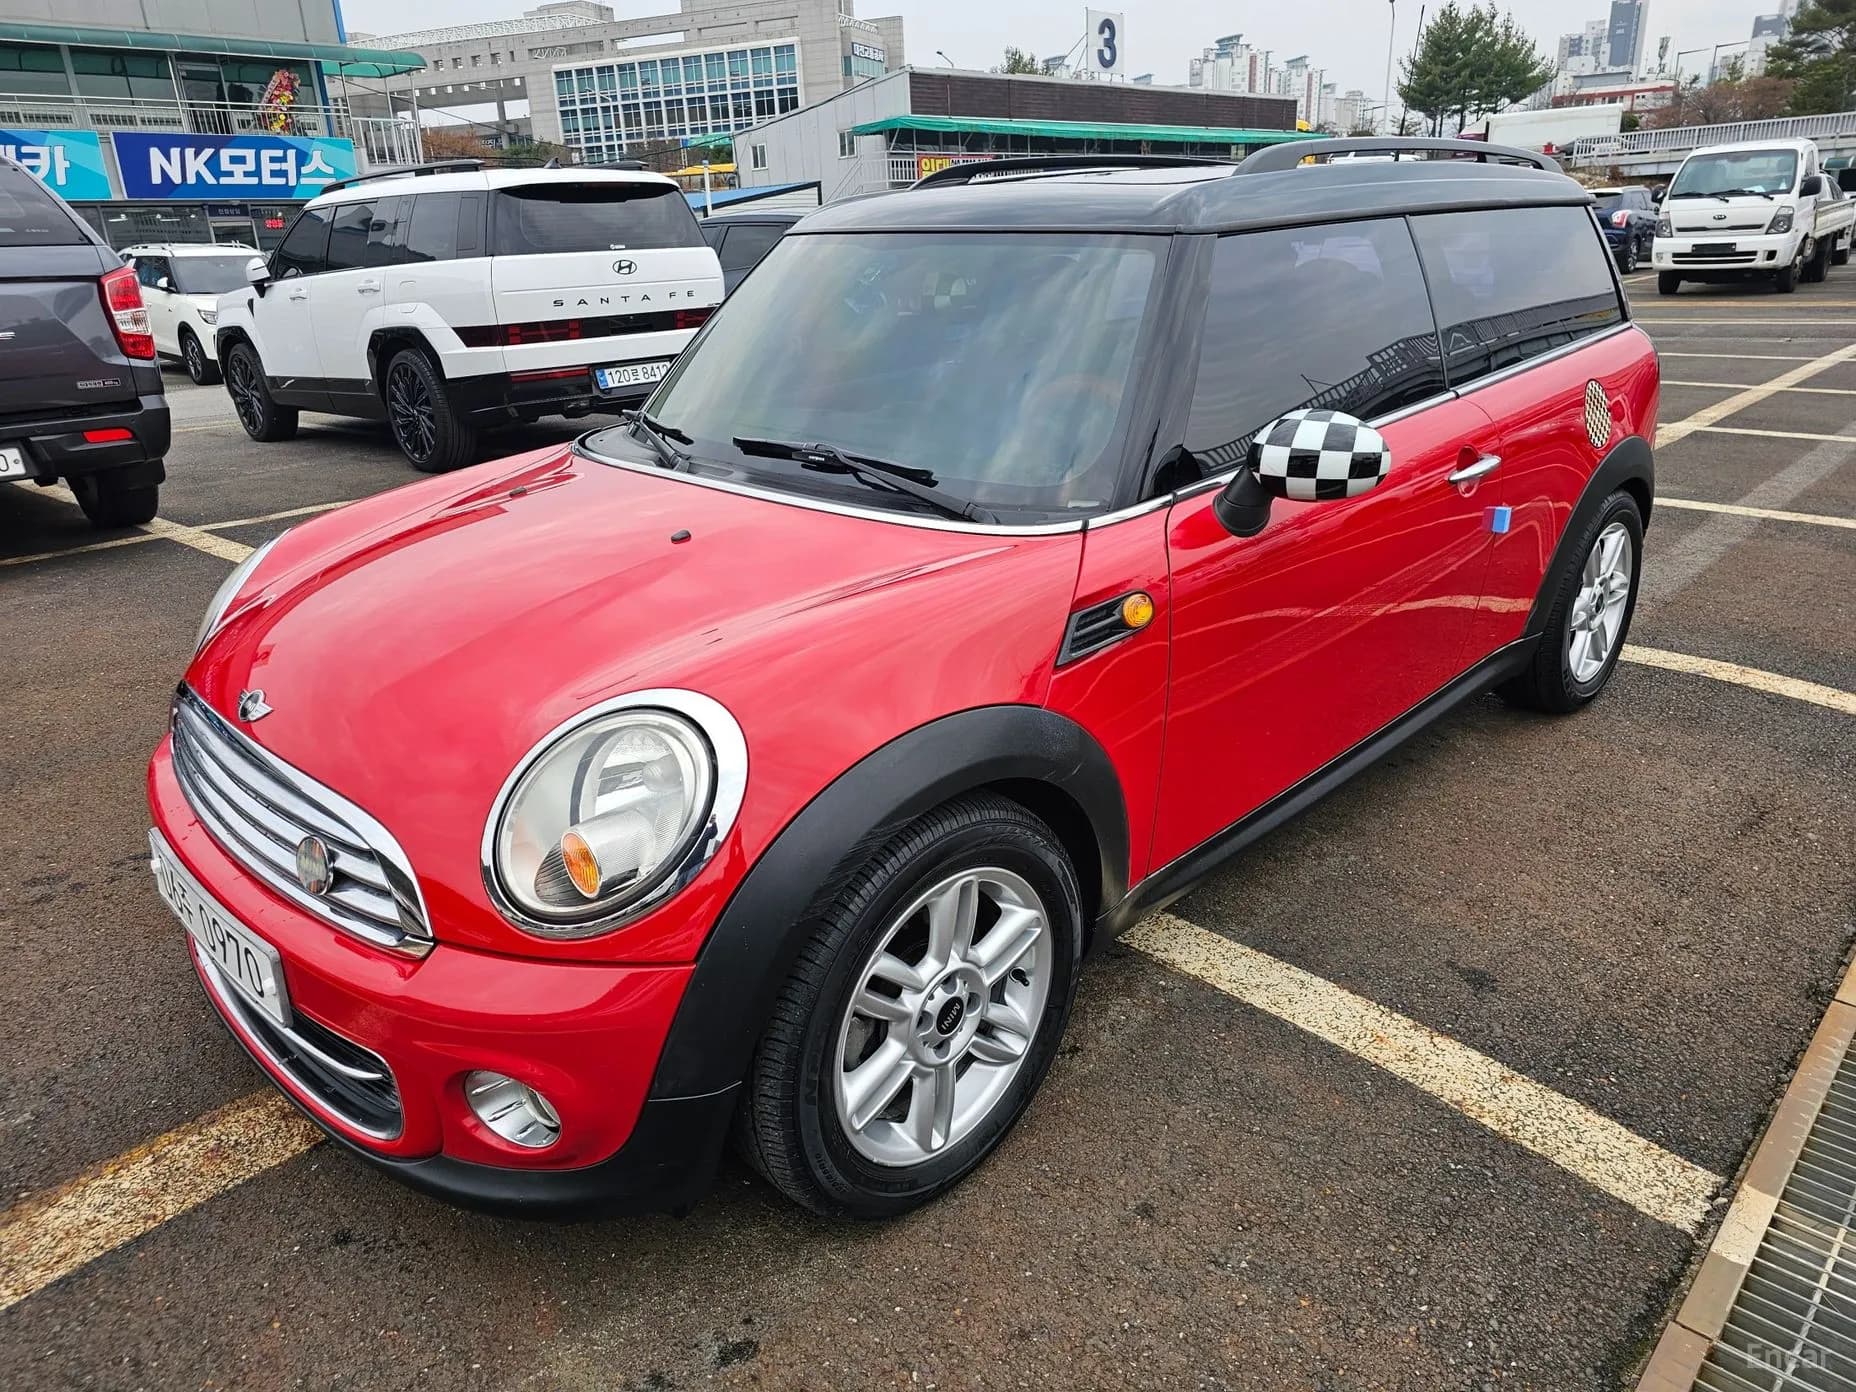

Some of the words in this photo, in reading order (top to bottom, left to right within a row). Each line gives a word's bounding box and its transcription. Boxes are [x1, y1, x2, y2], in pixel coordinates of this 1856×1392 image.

[1097, 18, 1117, 68] 3
[149, 147, 336, 187] NK모터스
[553, 294, 651, 307] SANTA
[669, 290, 695, 299] FE
[199, 903, 265, 998] 0970
[941, 1002, 961, 1030] MINI
